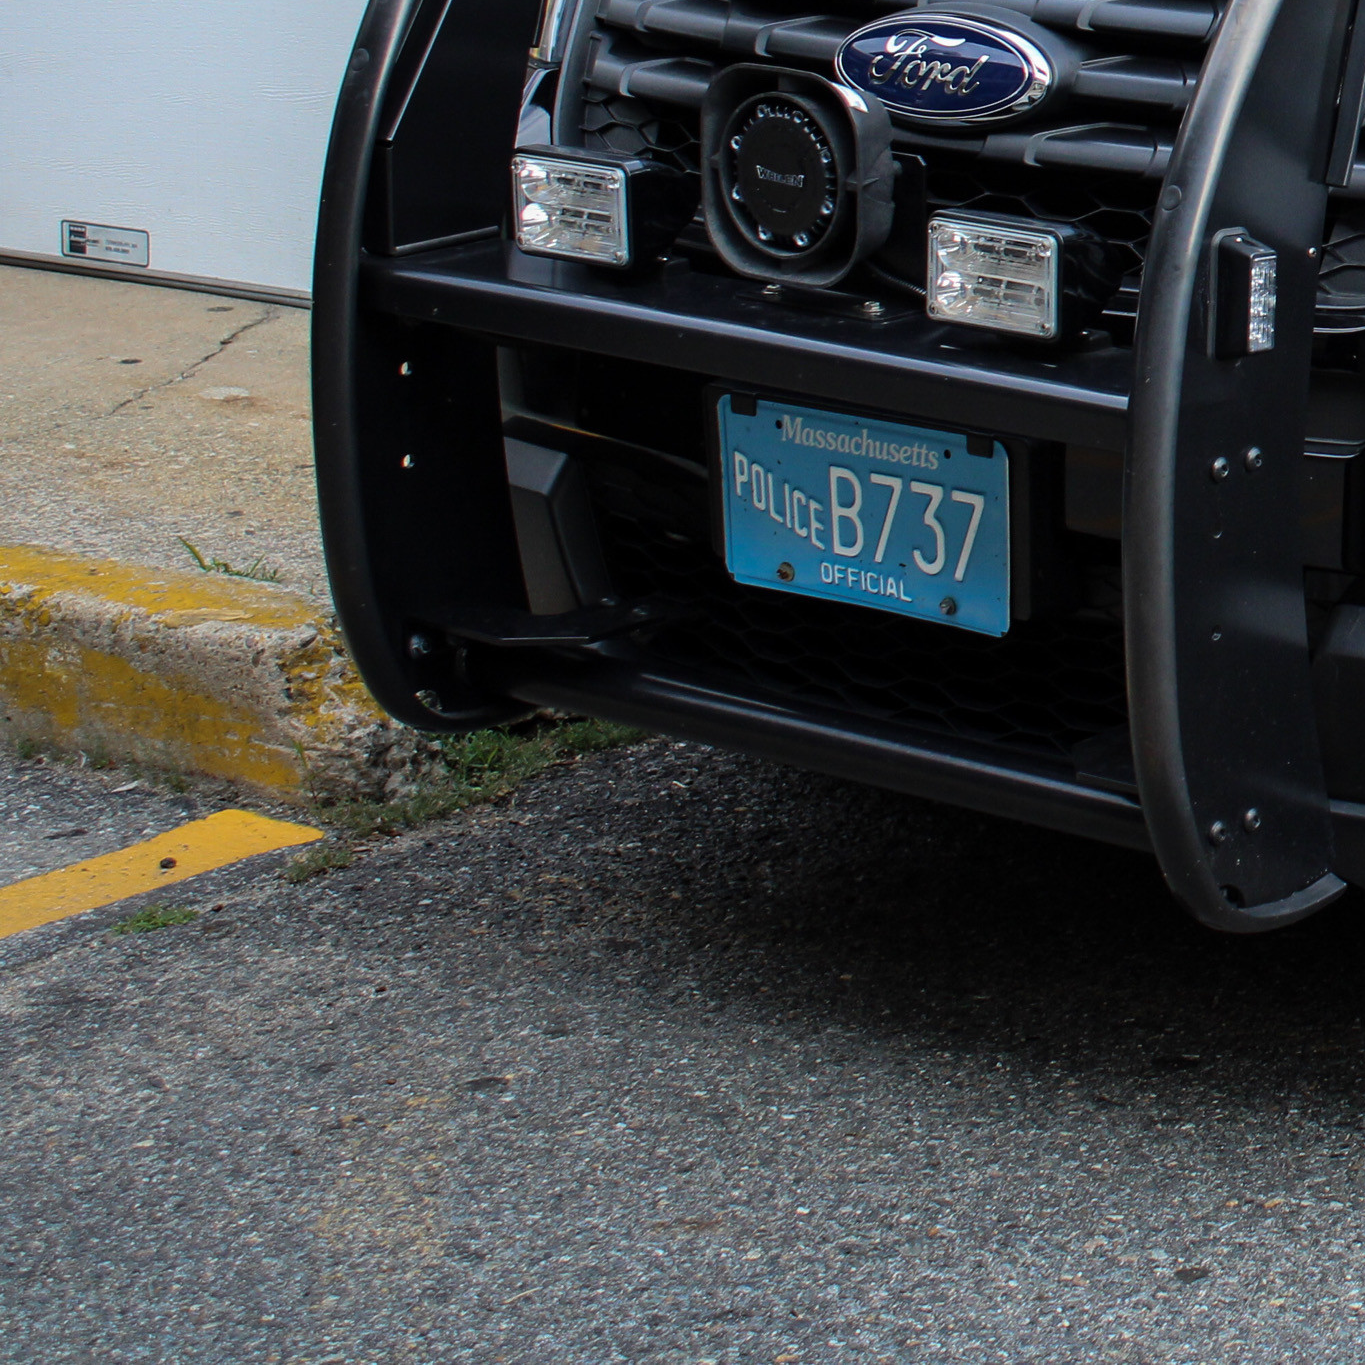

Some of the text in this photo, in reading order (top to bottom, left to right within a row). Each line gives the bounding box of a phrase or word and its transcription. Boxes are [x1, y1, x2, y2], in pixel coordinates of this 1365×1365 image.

[868, 28, 990, 96] Ford
[781, 415, 940, 470] Massachusetts
[734, 451, 985, 582] POLICE B737
[820, 562, 913, 602] OFFICIAL
